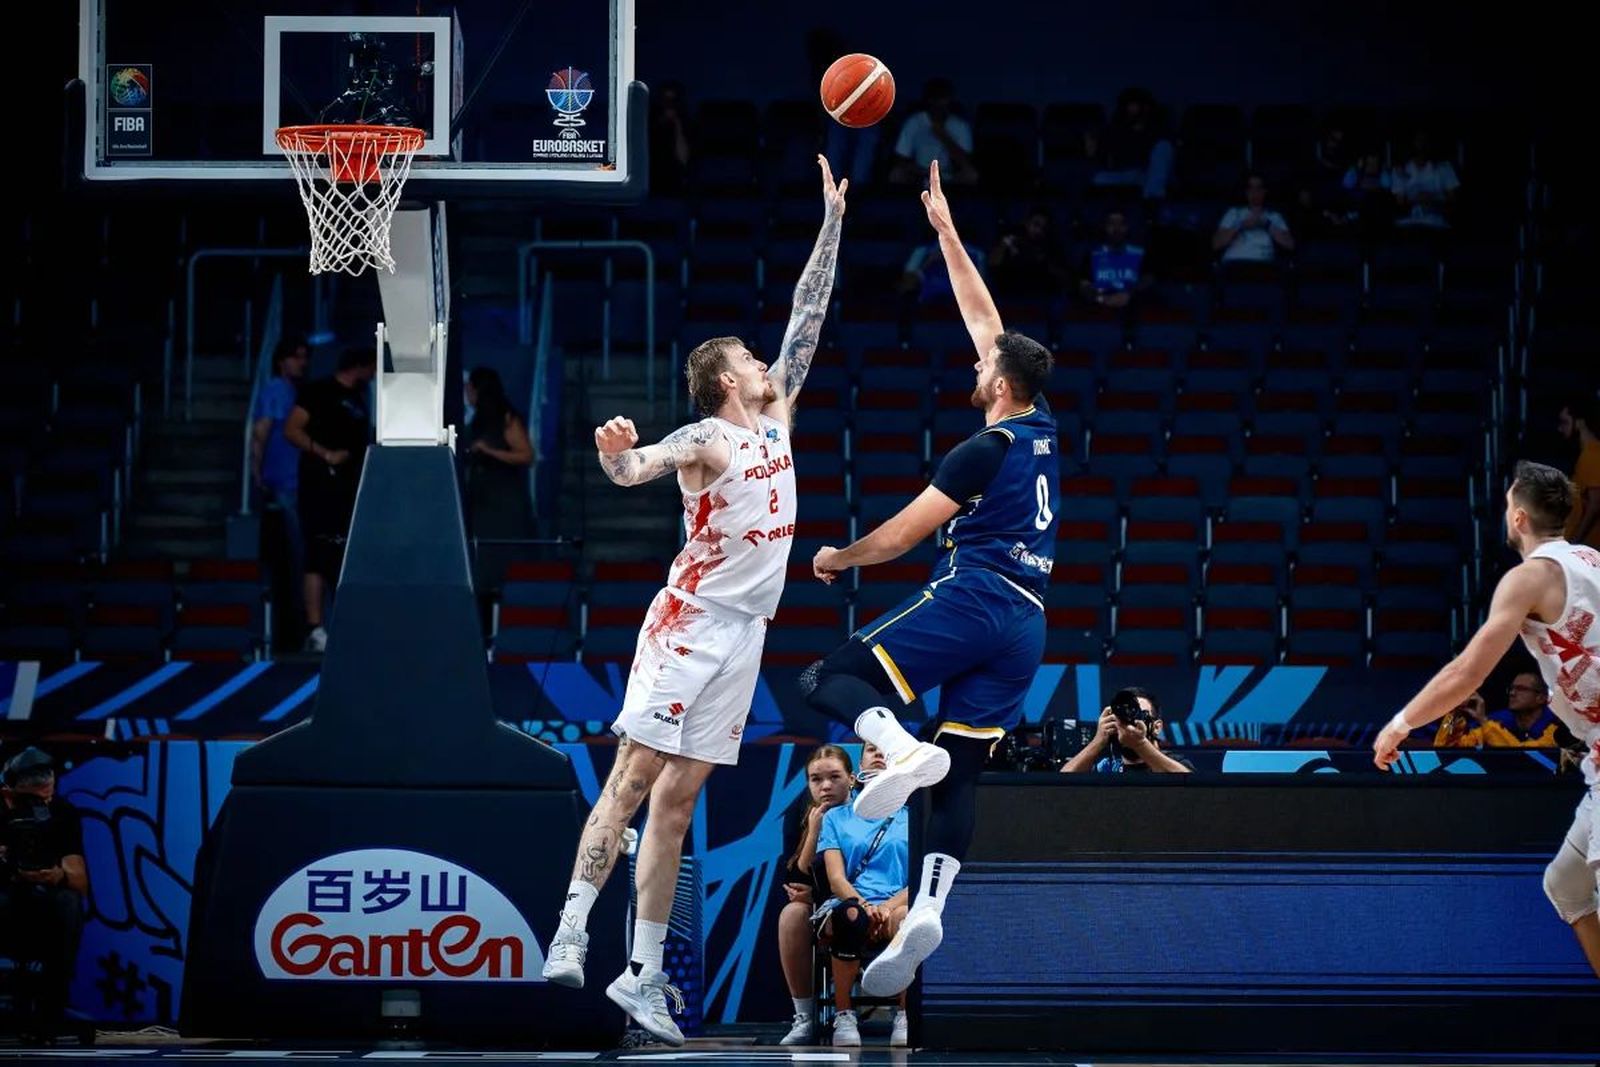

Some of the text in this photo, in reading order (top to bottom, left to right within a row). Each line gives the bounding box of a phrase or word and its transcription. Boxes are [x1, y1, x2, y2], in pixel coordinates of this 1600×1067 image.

[114, 117, 145, 132] FIBA
[532, 139, 606, 153] EUROBASKET
[744, 454, 792, 482] POLSKA
[769, 488, 779, 514] 2
[1035, 473, 1054, 531] 0
[306, 869, 468, 915] 百岁山
